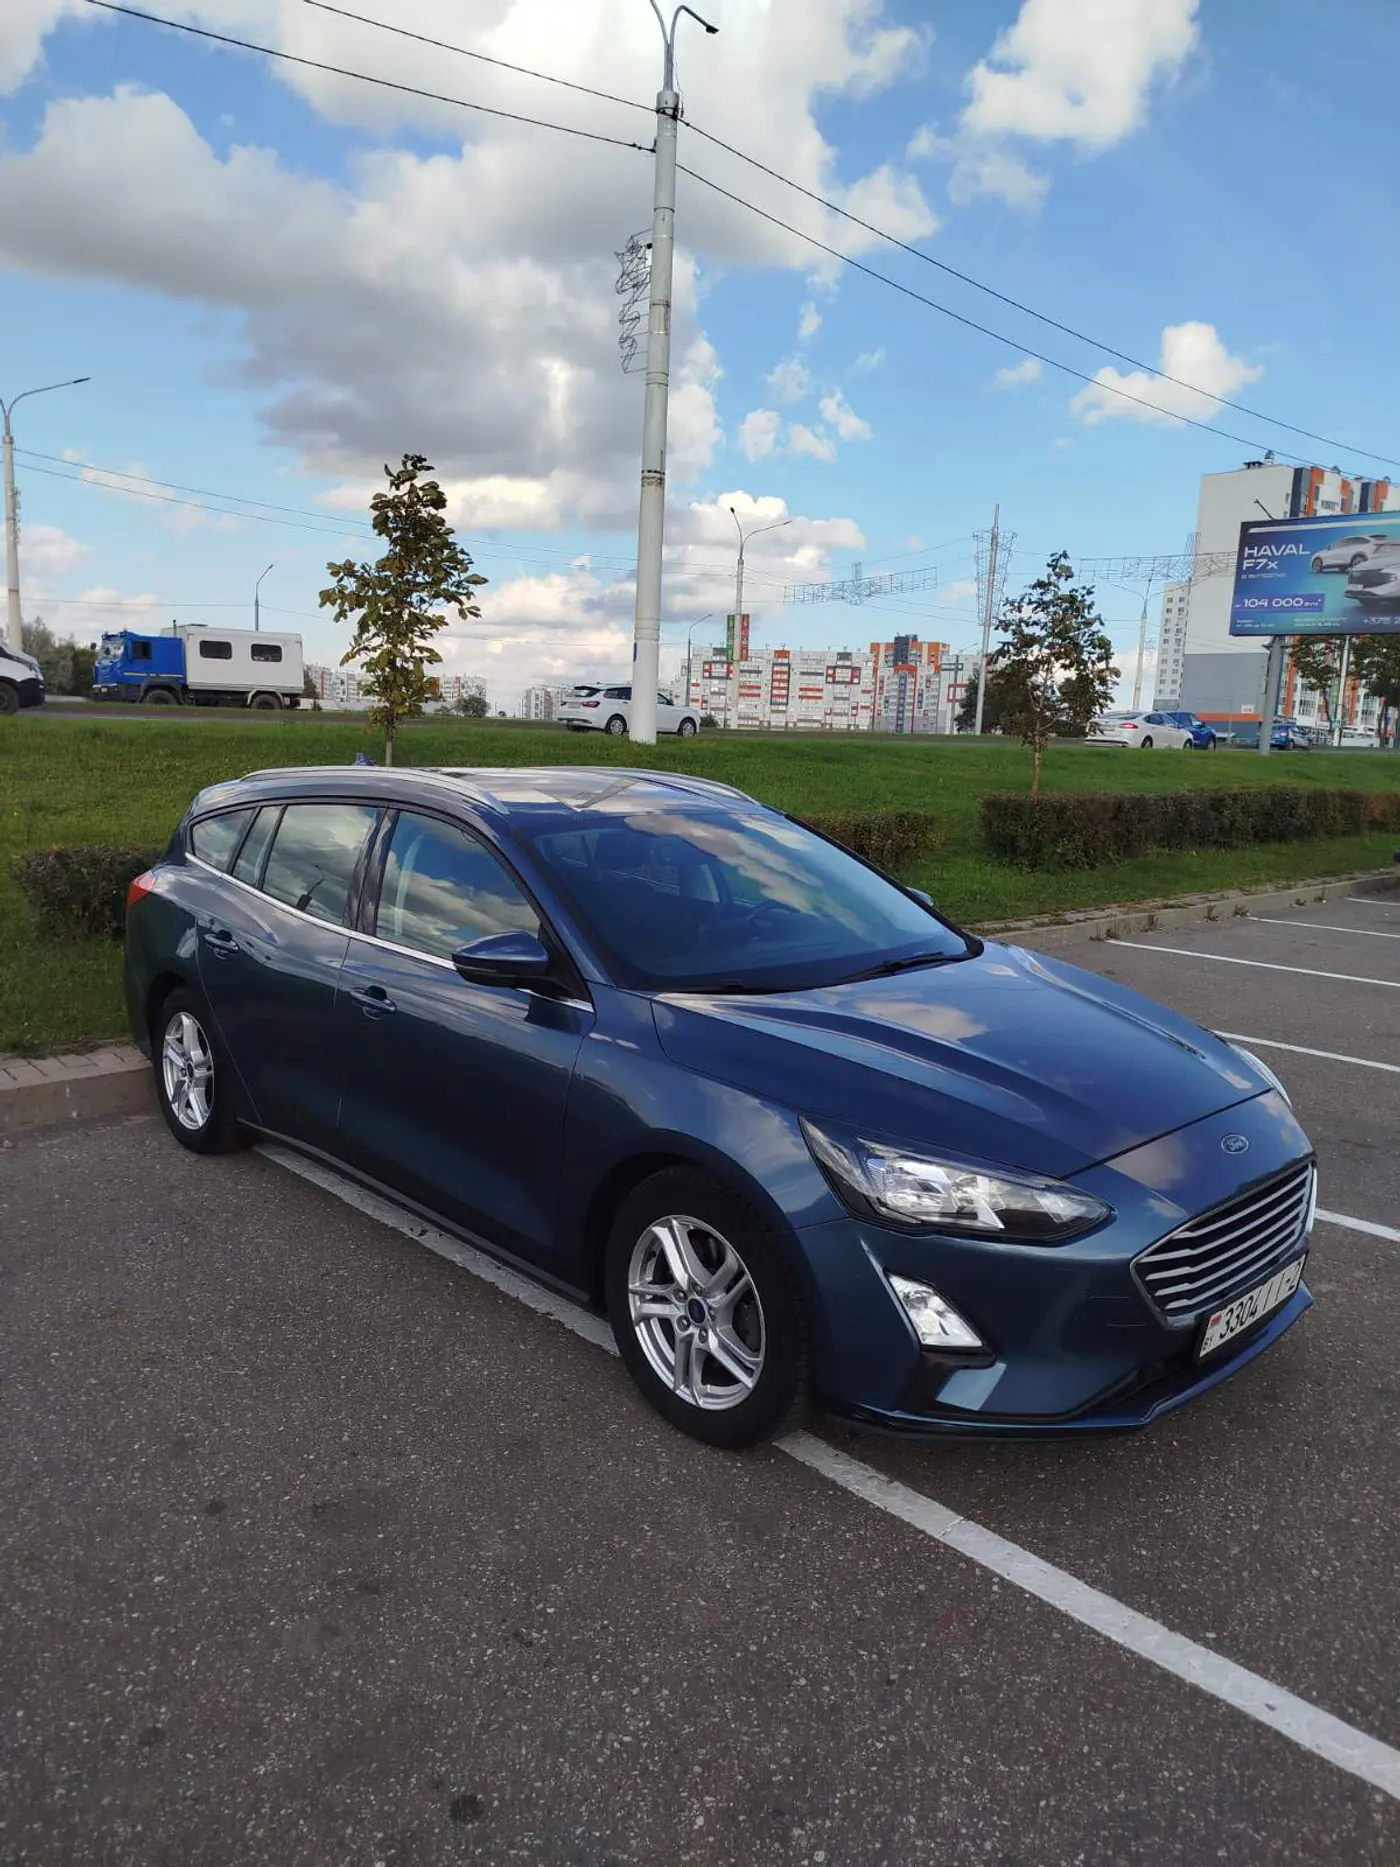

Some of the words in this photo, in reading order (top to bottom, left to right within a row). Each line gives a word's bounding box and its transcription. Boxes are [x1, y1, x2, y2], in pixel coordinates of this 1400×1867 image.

[1244, 543, 1310, 557] HAVAL
[1242, 558, 1279, 570] F7x
[1243, 598, 1268, 607] 104
[1272, 597, 1303, 607] 000
[1220, 1288, 1262, 1339] 3304
